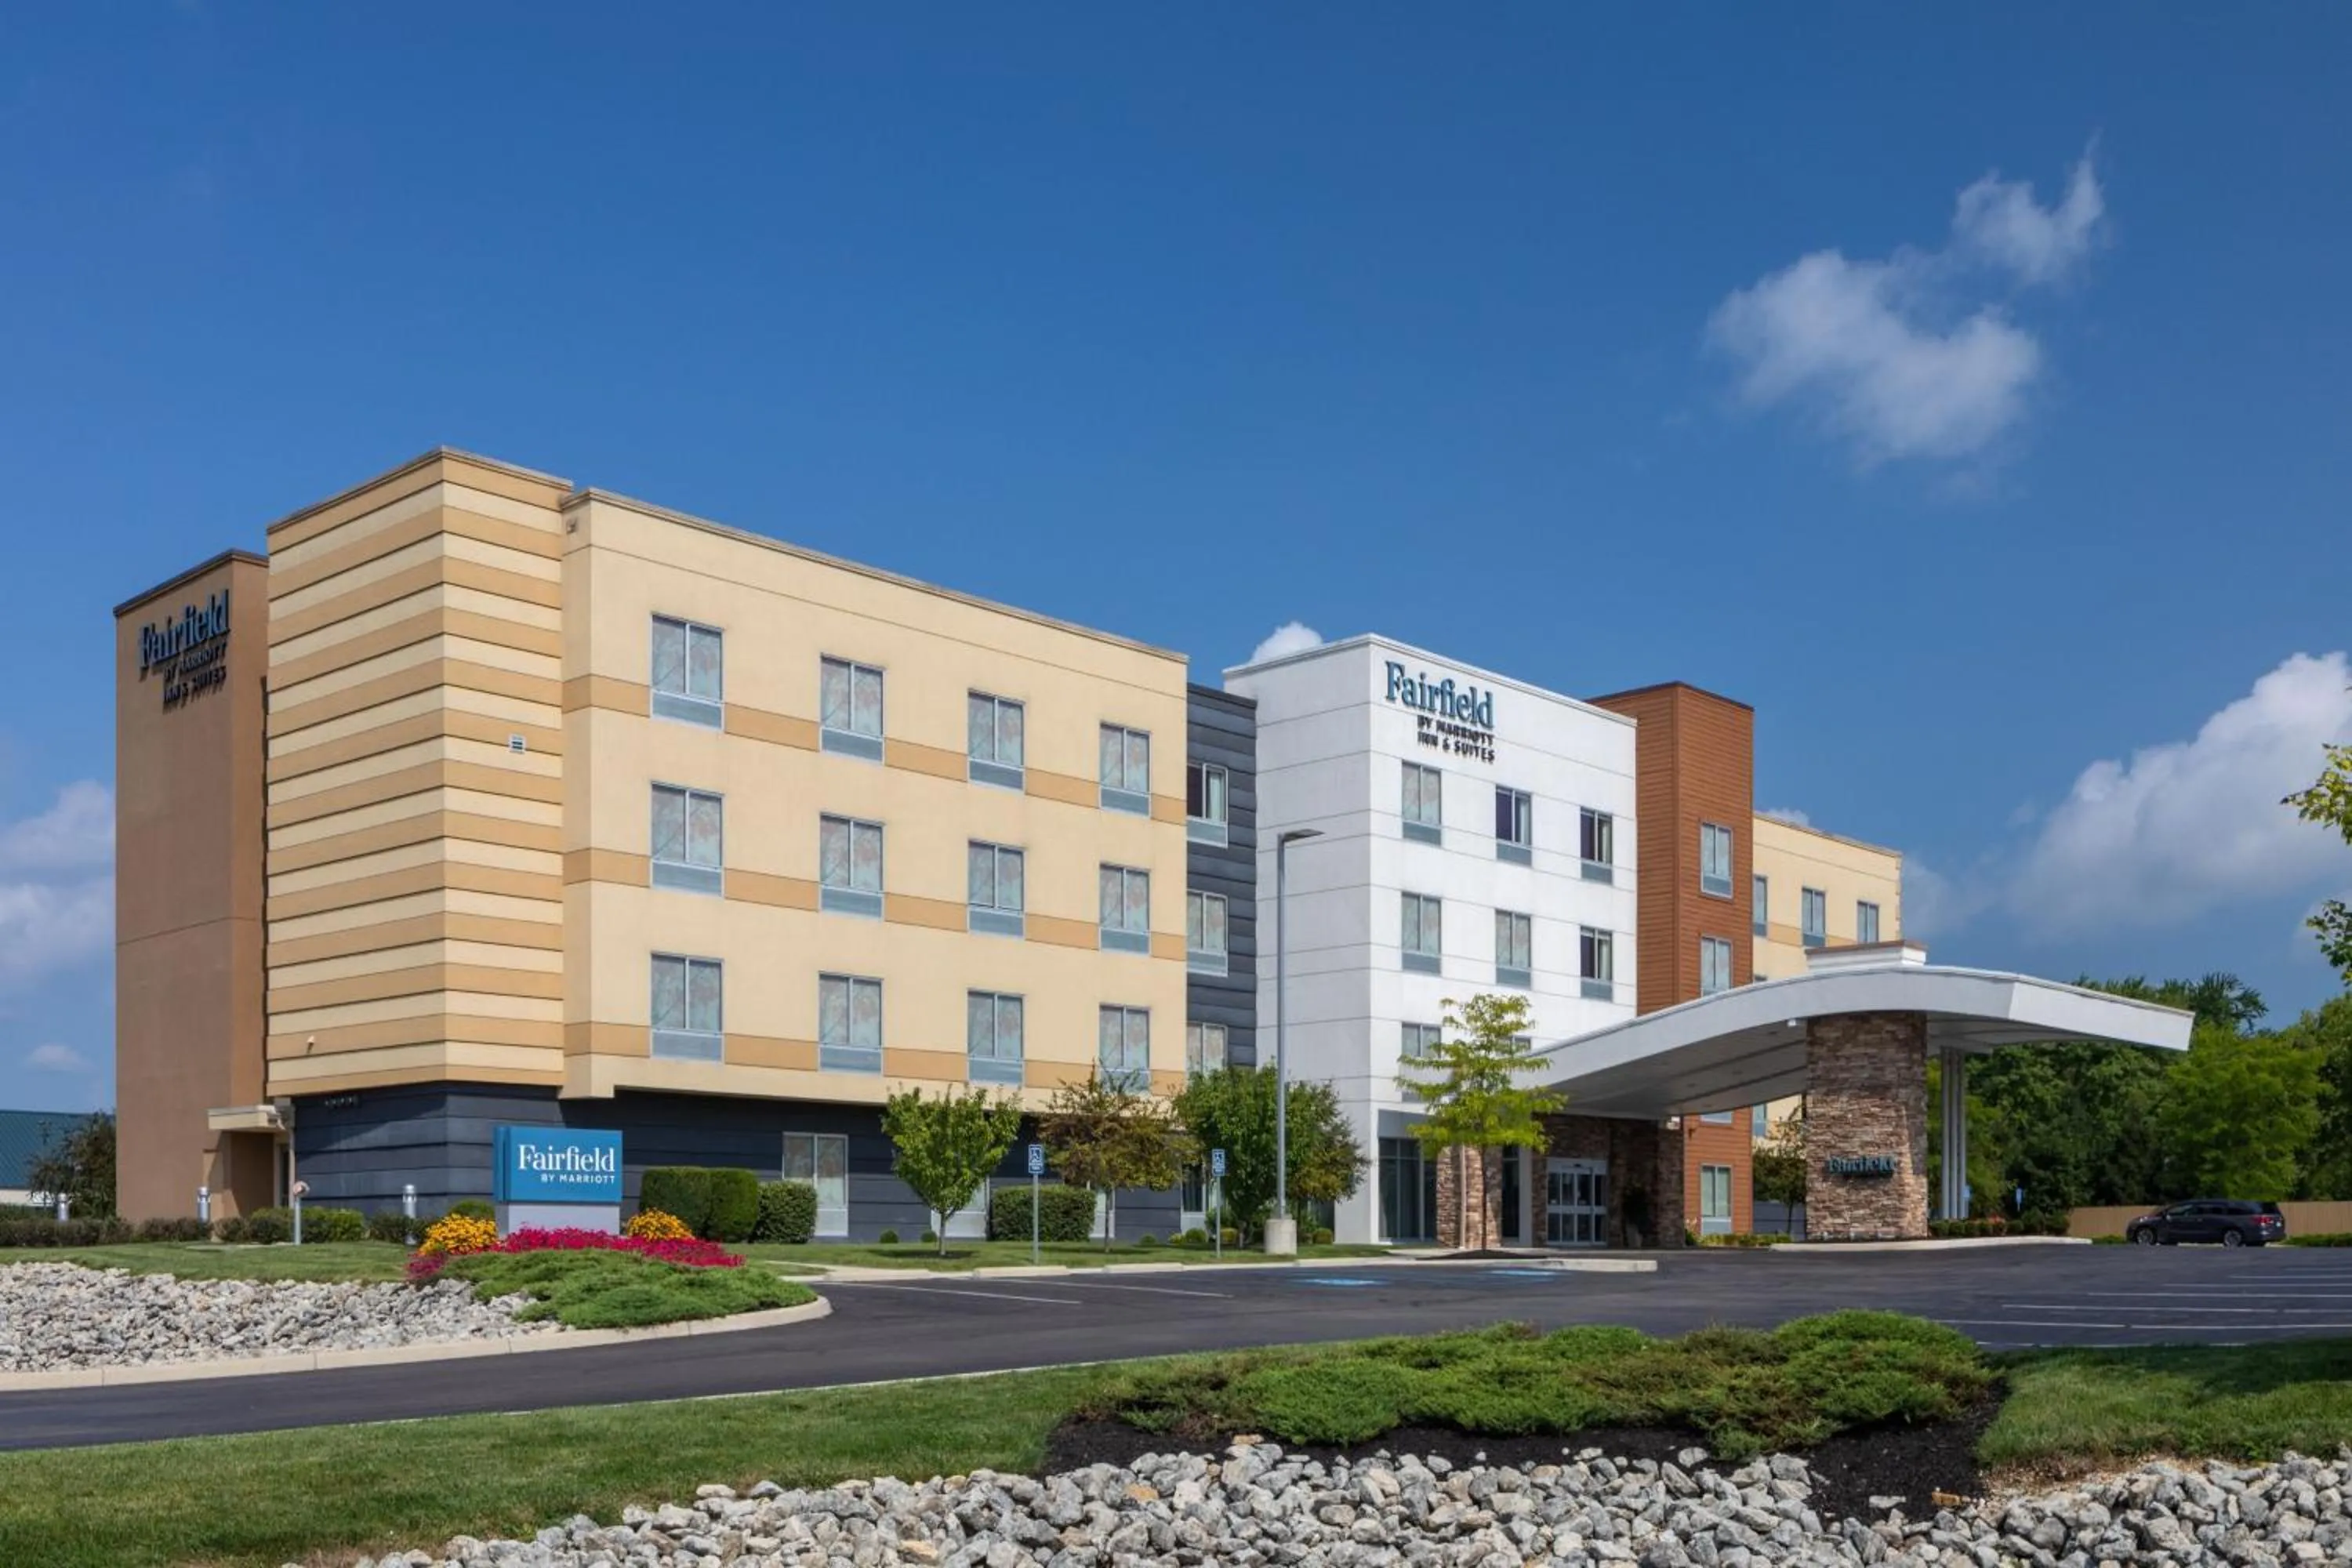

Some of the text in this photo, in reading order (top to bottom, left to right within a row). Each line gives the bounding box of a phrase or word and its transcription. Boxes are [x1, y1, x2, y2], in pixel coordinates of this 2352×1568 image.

[140, 589, 230, 667] Fairfield
[1385, 661, 1494, 730] Fairfield
[1417, 714, 1494, 746] BY MARRIOTT
[1417, 731, 1495, 764] INN & SUITES
[517, 1144, 615, 1172] Fairfield
[541, 1174, 615, 1184] BY MARRIOTT
